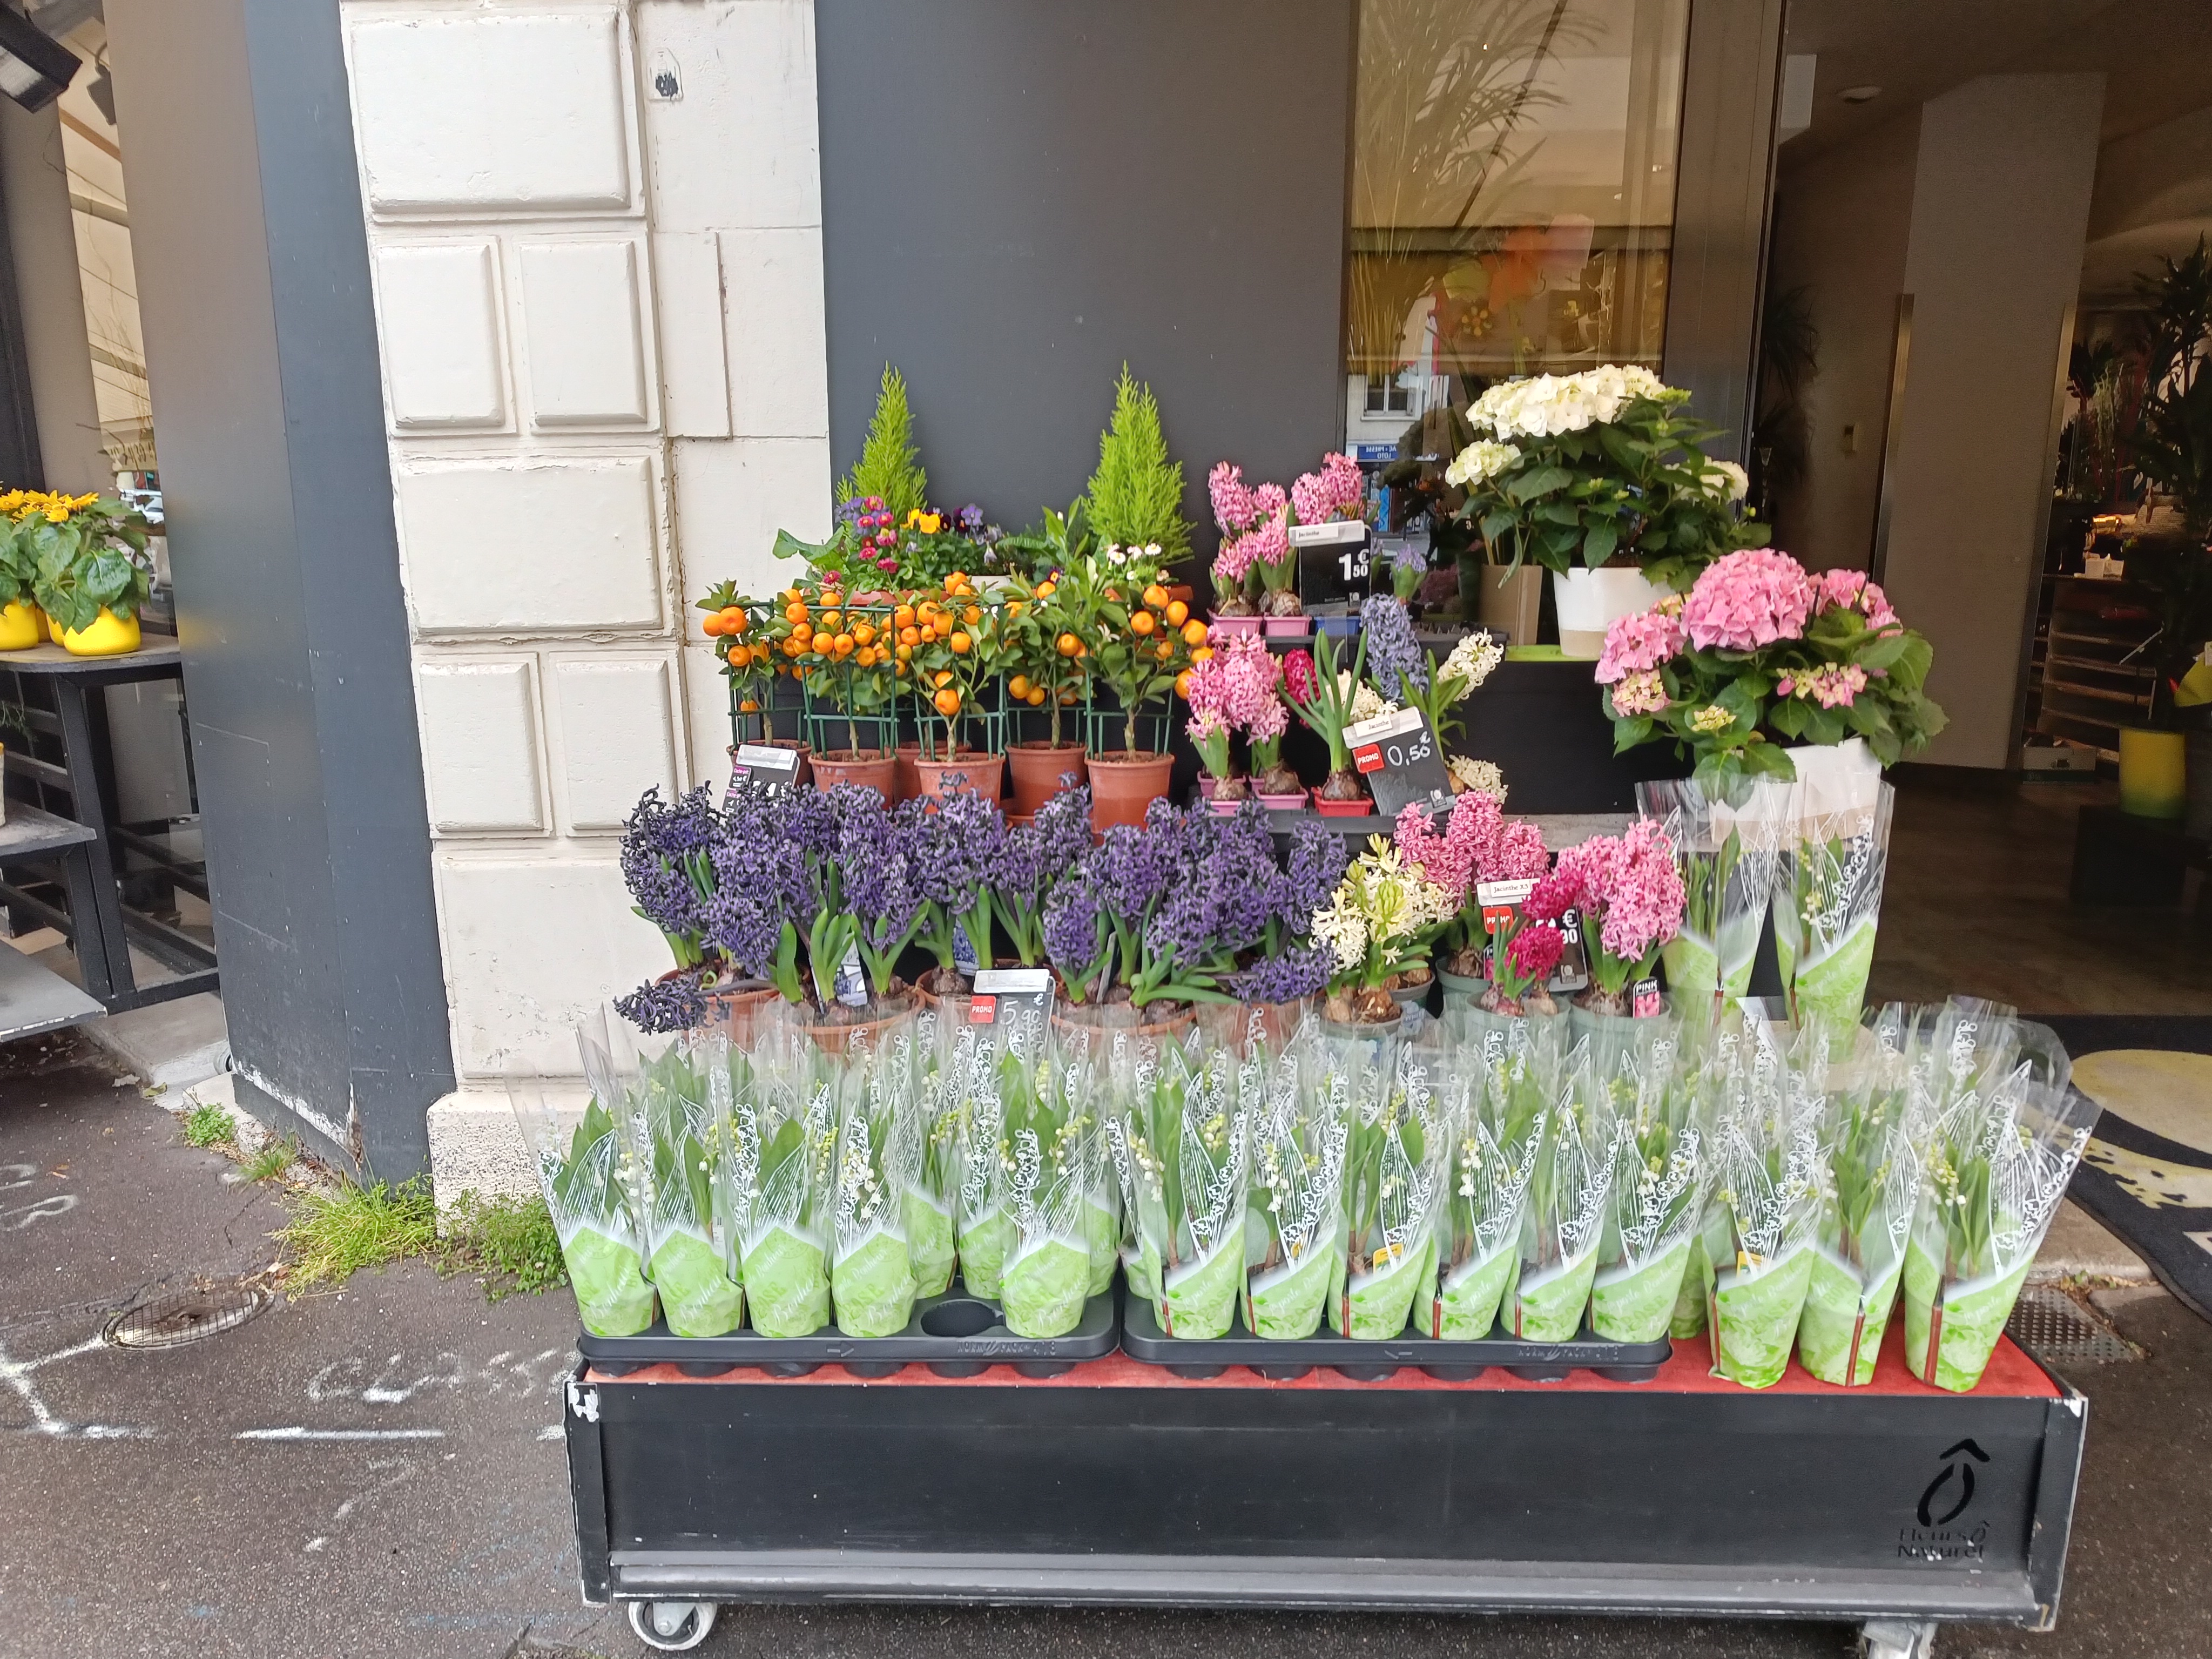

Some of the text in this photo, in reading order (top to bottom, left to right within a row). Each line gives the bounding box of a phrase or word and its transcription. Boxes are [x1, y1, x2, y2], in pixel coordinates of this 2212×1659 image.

[1338, 553, 1351, 581] 1
[1357, 752, 1379, 765] PROMO
[1494, 885, 1519, 893] Jacinthe
[1562, 909, 1577, 928] €
[1635, 979, 1658, 994] PINK
[1033, 993, 1044, 1006] €
[972, 1005, 993, 1013] PROMO
